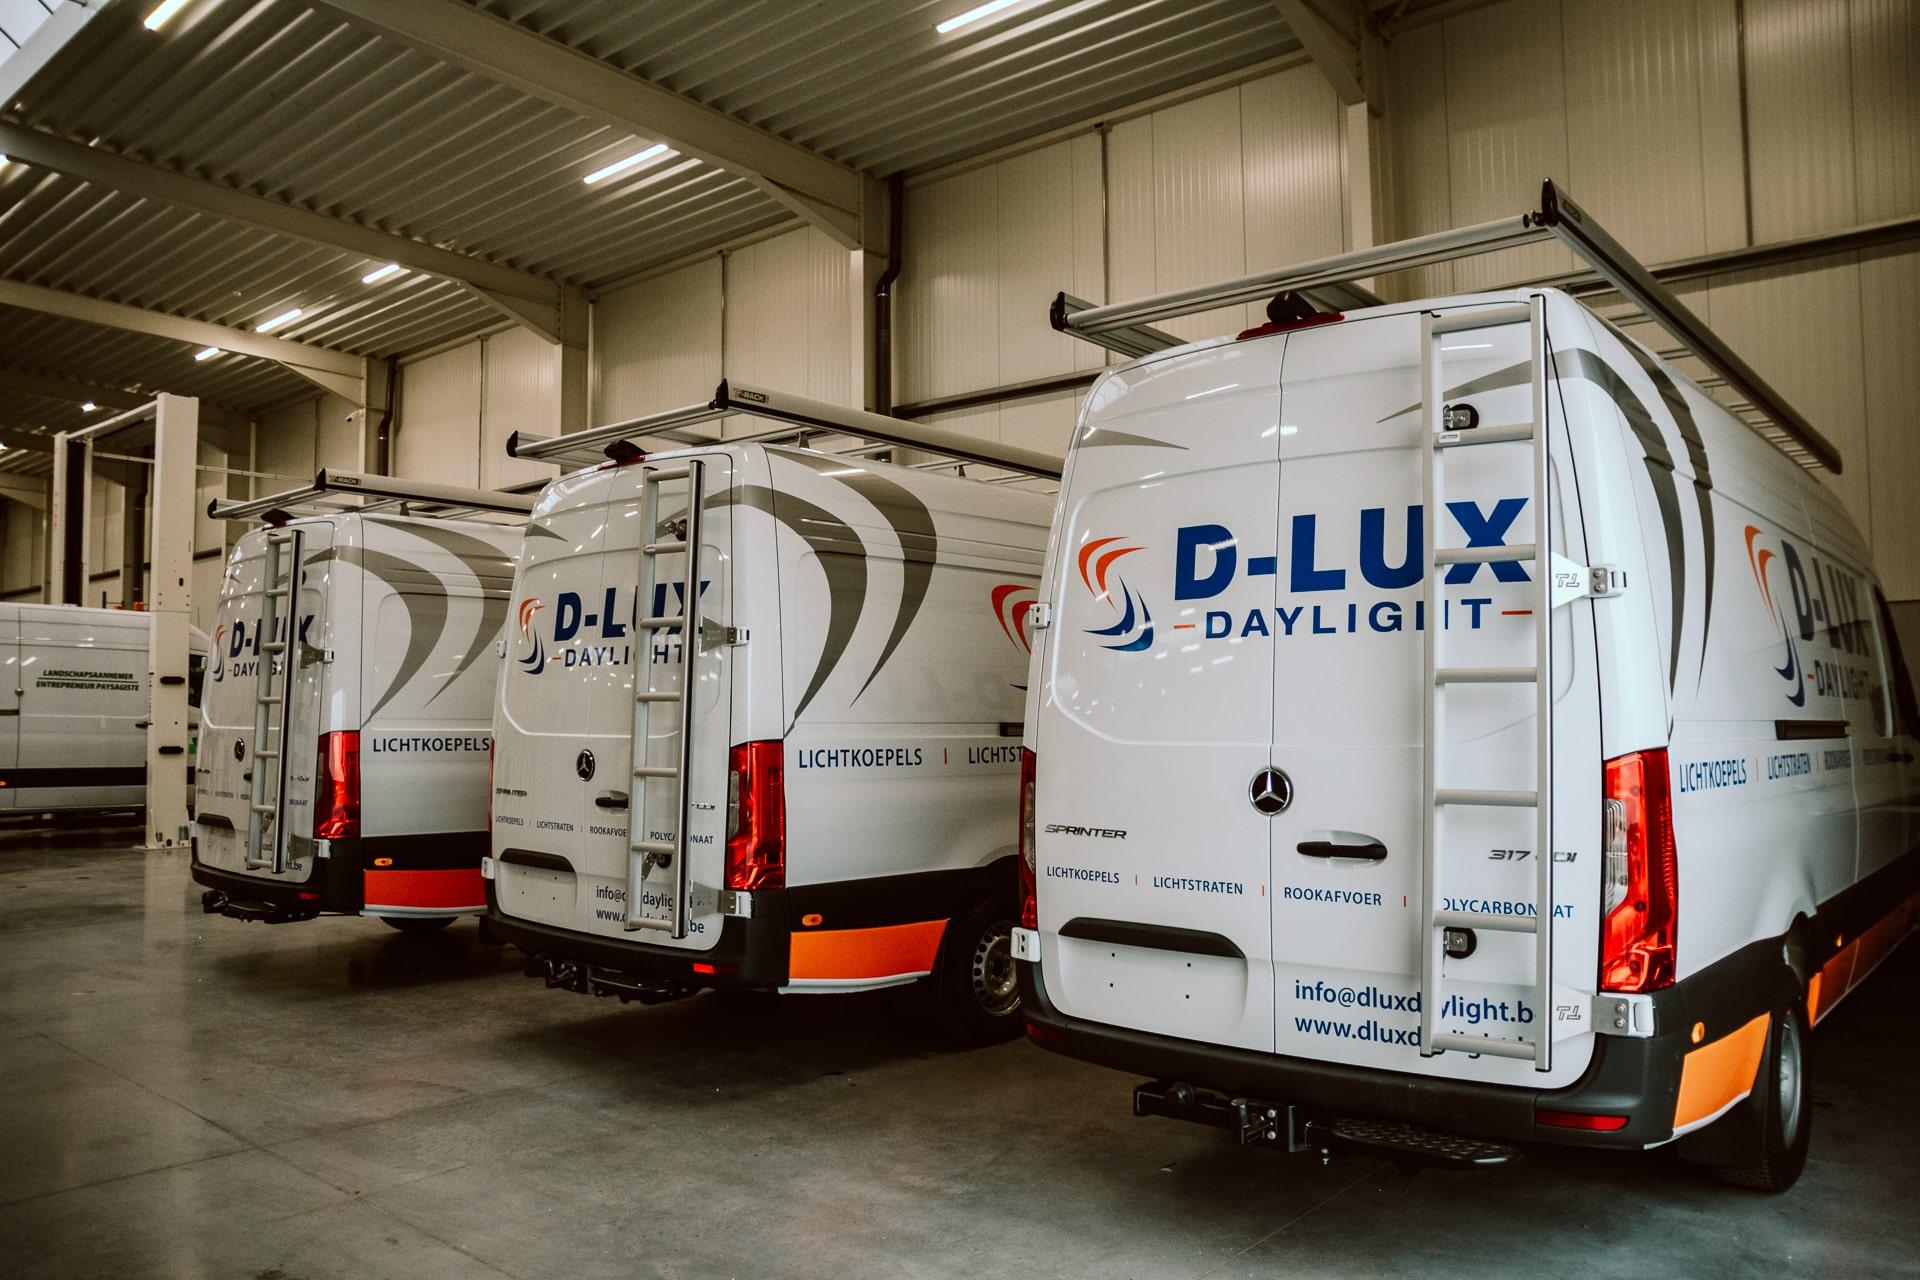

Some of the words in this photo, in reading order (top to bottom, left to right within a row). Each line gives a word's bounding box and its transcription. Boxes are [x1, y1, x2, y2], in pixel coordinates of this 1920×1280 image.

[1174, 498, 1532, 600] D-LUX
[1781, 539, 1870, 657] D-LUX
[43, 669, 134, 680] LANDSCHAPSAANNEMER
[36, 681, 95, 690] ENTREPRENEUR
[96, 684, 140, 692] PAYSAGISTE
[373, 737, 490, 753] LICHTKOEPELS
[799, 748, 923, 768] LICHTKOEPELS
[968, 746, 1022, 764] LICHTST
[1679, 758, 1747, 793] LICHTKOEPELS
[536, 820, 574, 832] LICHTSTRATEN
[590, 825, 627, 838] ROOKAFVOE
[1045, 823, 1127, 840] SPRINTER
[1488, 849, 1531, 861] 317
[1047, 866, 1120, 884] LICHTKOEPELS
[1153, 876, 1243, 895] LICHTSTRATEN
[1284, 886, 1382, 906] ROOKAFVOER
